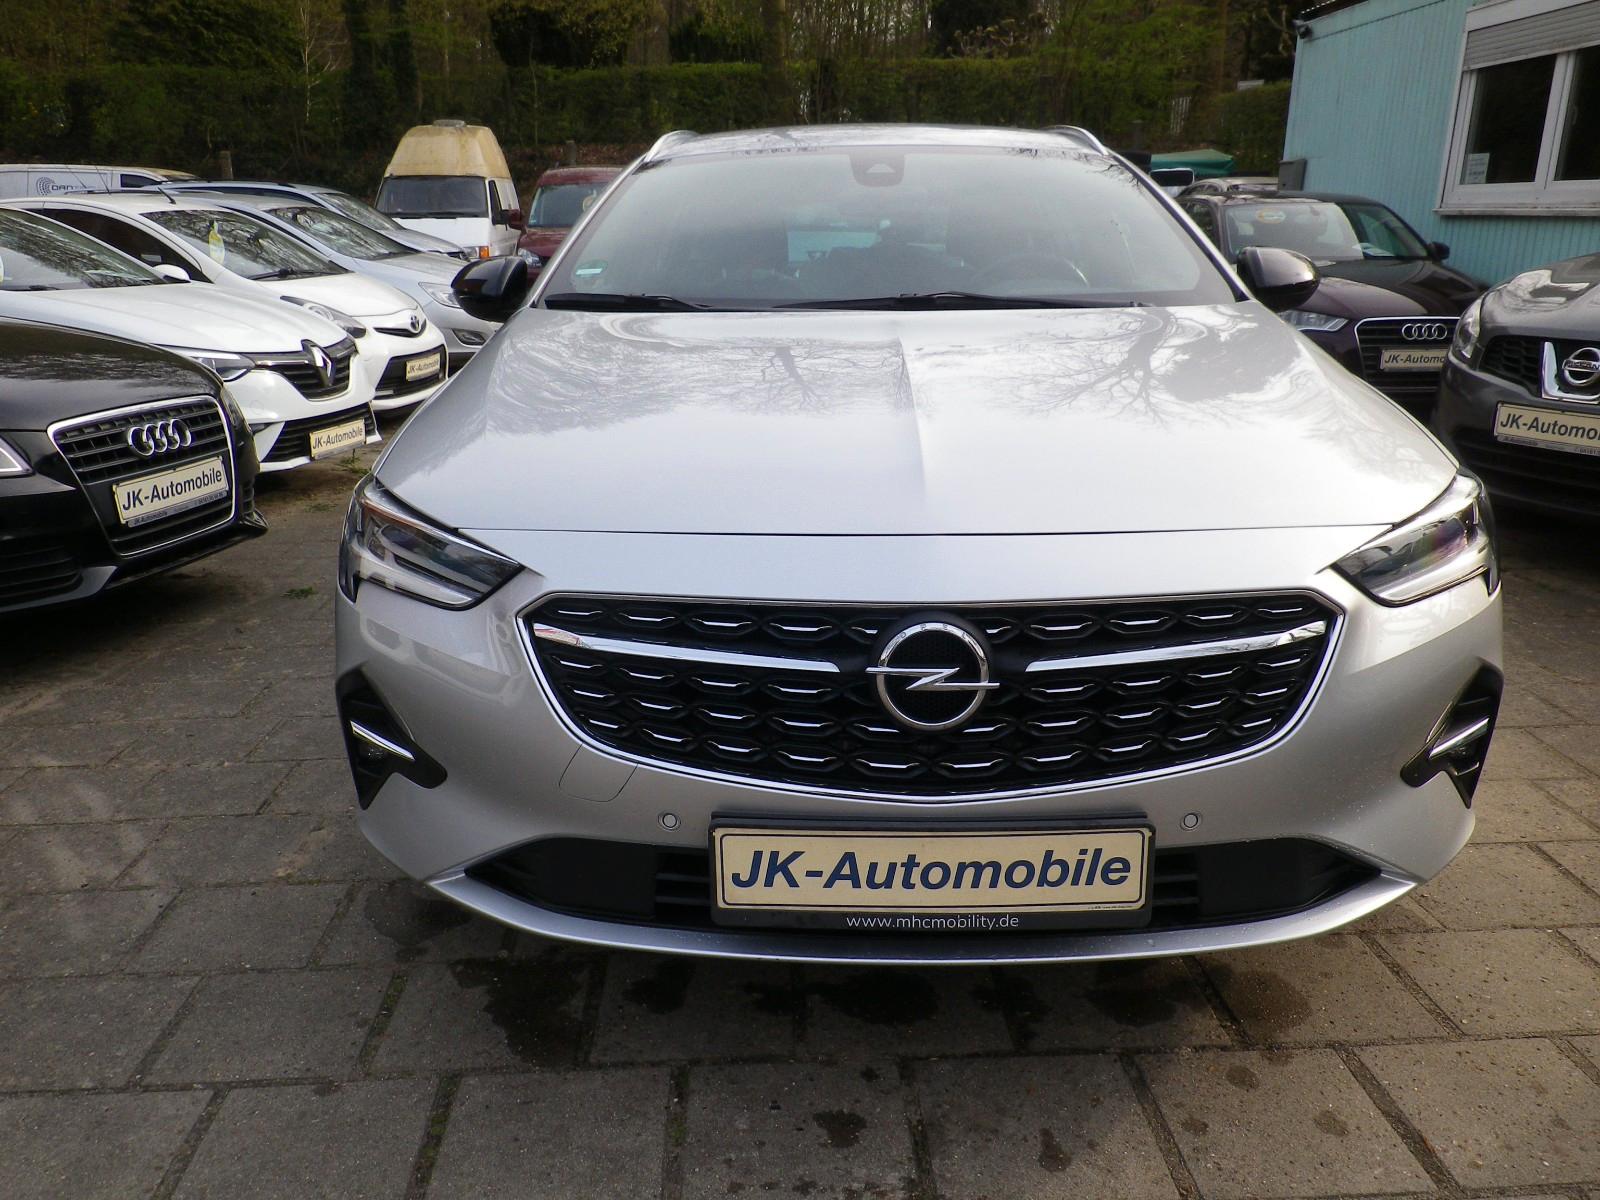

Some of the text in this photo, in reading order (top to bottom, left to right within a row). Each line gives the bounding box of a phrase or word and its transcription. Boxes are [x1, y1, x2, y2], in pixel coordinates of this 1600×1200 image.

[1500, 412, 1600, 441] JK-Automo
[122, 467, 223, 511] JK-Automobile
[901, 623, 968, 640] OPEL
[731, 848, 1131, 890] JK-Automobile
[846, 914, 1019, 930] www.mhcmobility.de
